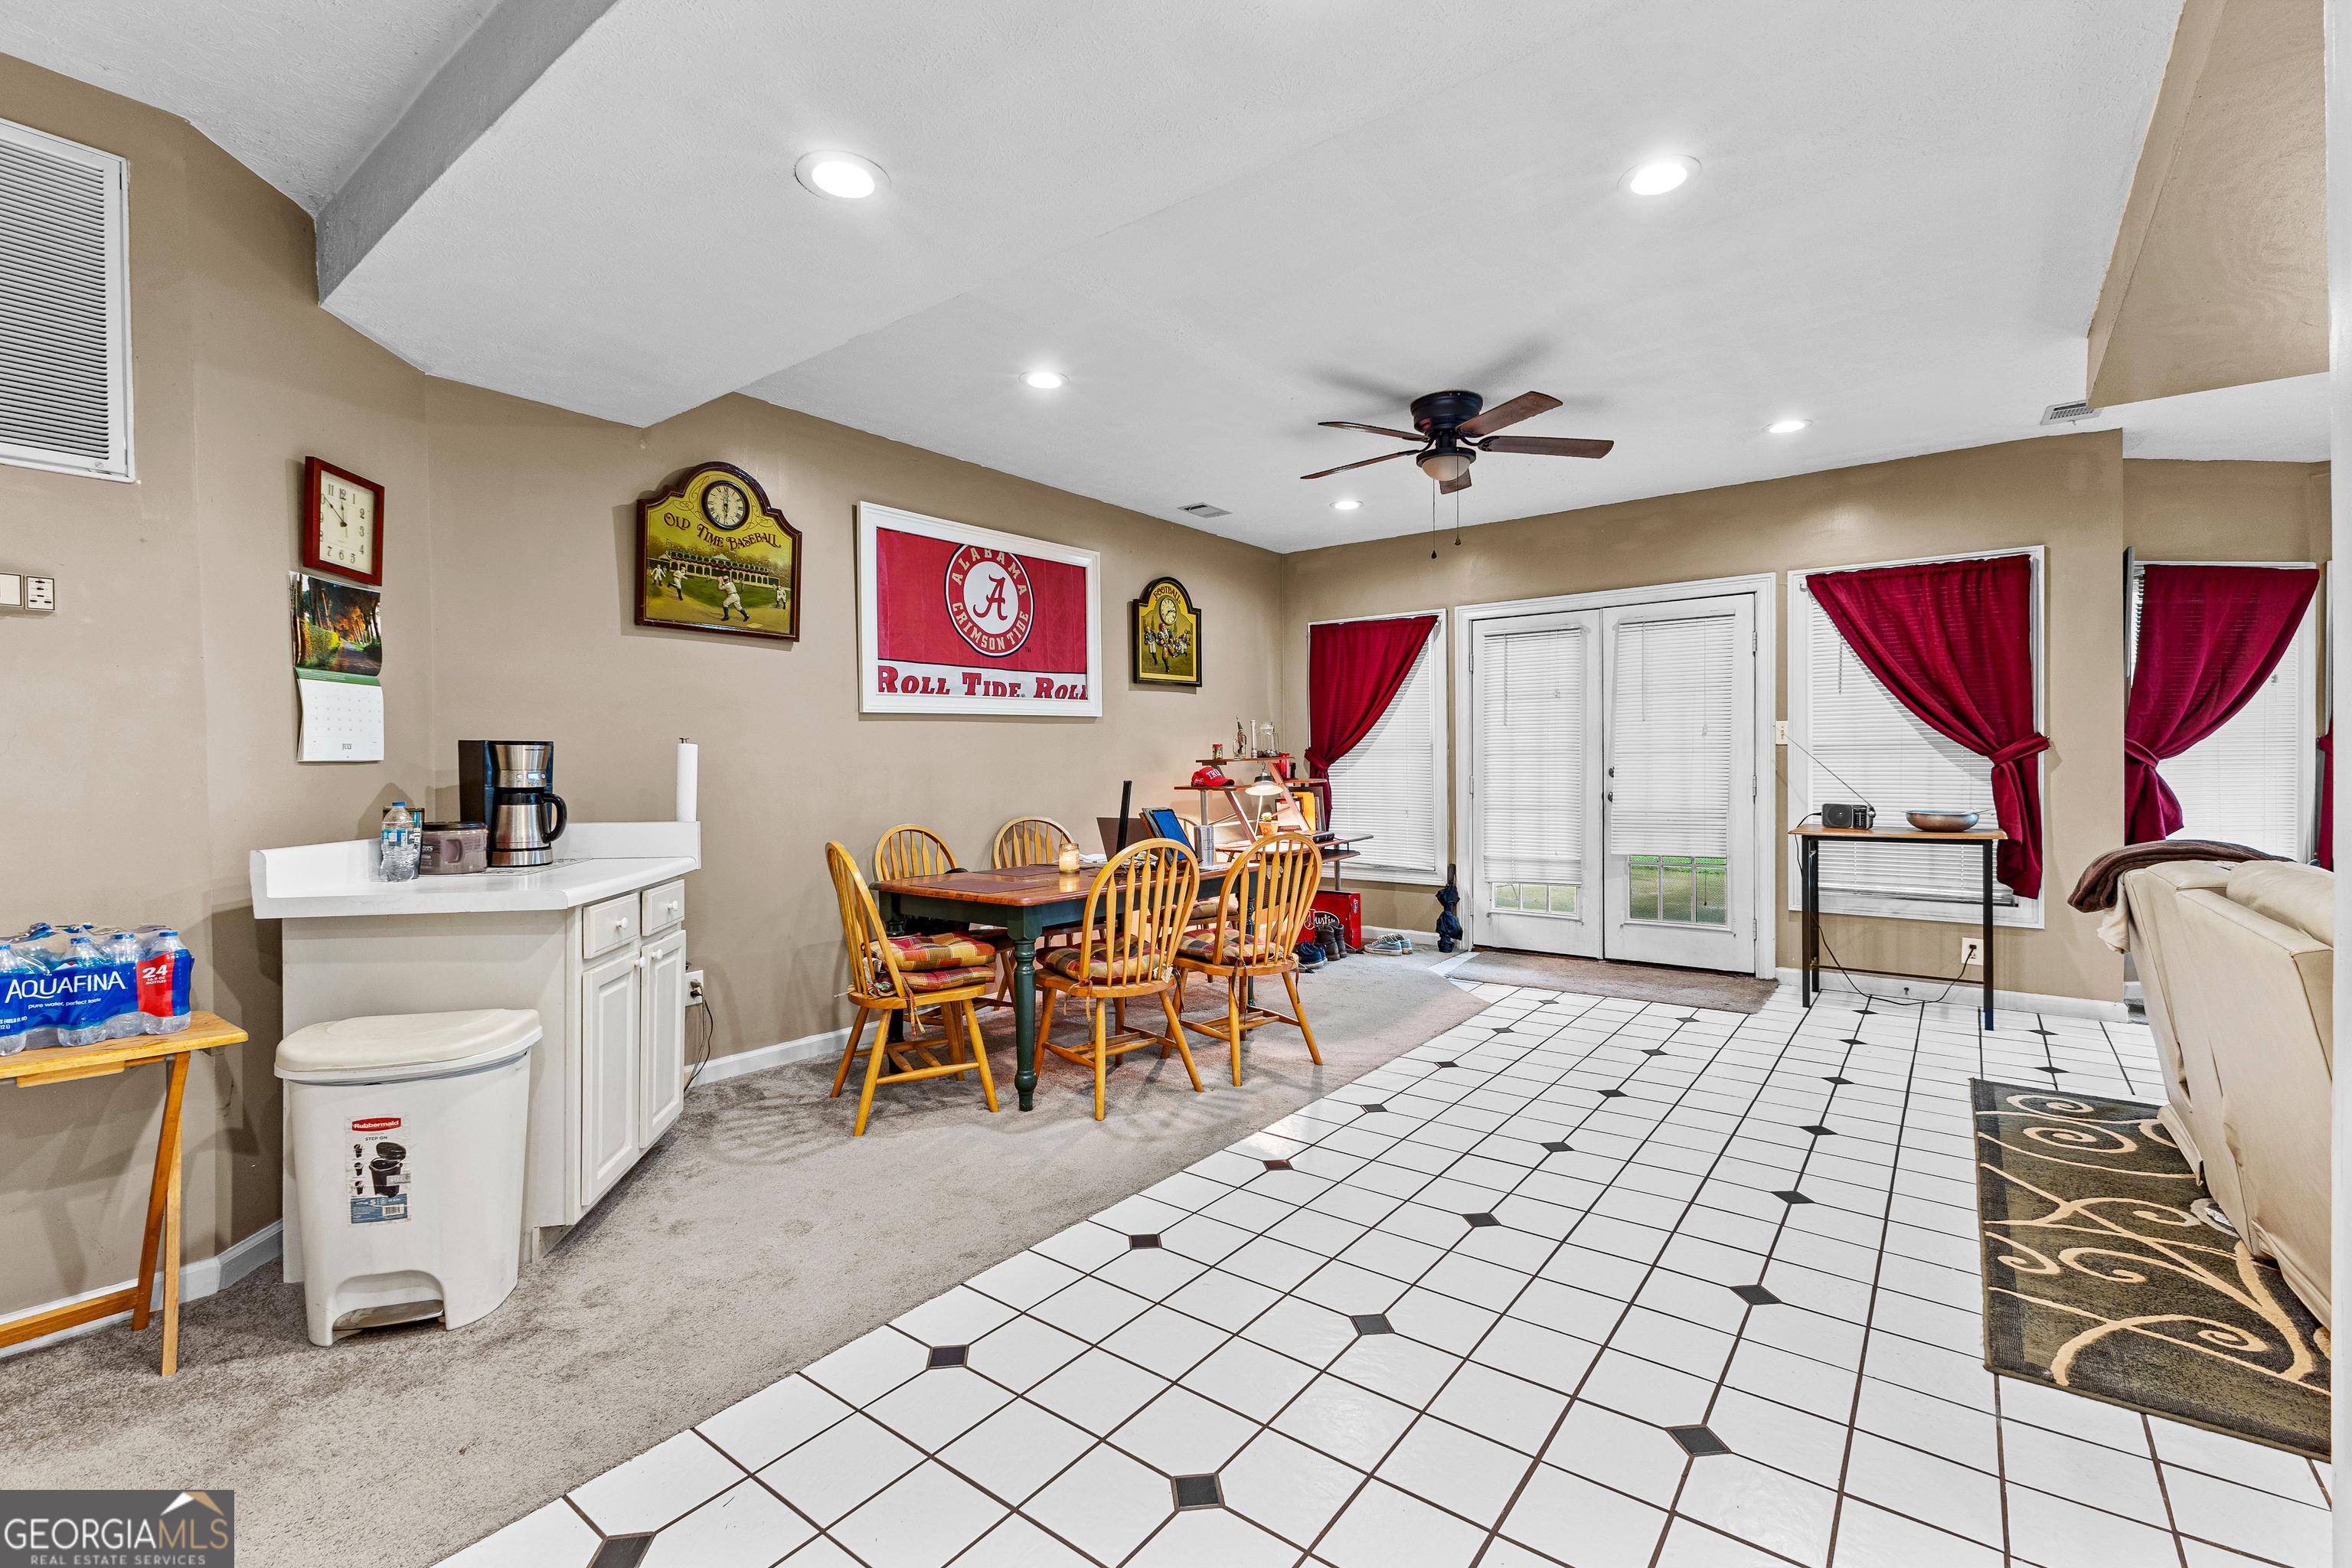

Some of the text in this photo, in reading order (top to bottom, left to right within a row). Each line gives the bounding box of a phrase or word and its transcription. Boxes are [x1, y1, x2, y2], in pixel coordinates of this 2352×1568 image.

[339, 488, 346, 501] 12
[360, 508, 364, 519] 2
[360, 526, 364, 537] 3
[663, 512, 781, 550] OLD TIME BASEBALL
[339, 550, 344, 560] 6
[951, 548, 1027, 596] ALABAMA
[973, 574, 1008, 621] A
[1153, 586, 1181, 604] FOOTBALL
[952, 602, 1029, 651] CRIMSON TIDE
[142, 965, 168, 978] 24
[5, 971, 126, 1003] AQUAFINA
[354, 1120, 399, 1129] Rubbermaid
